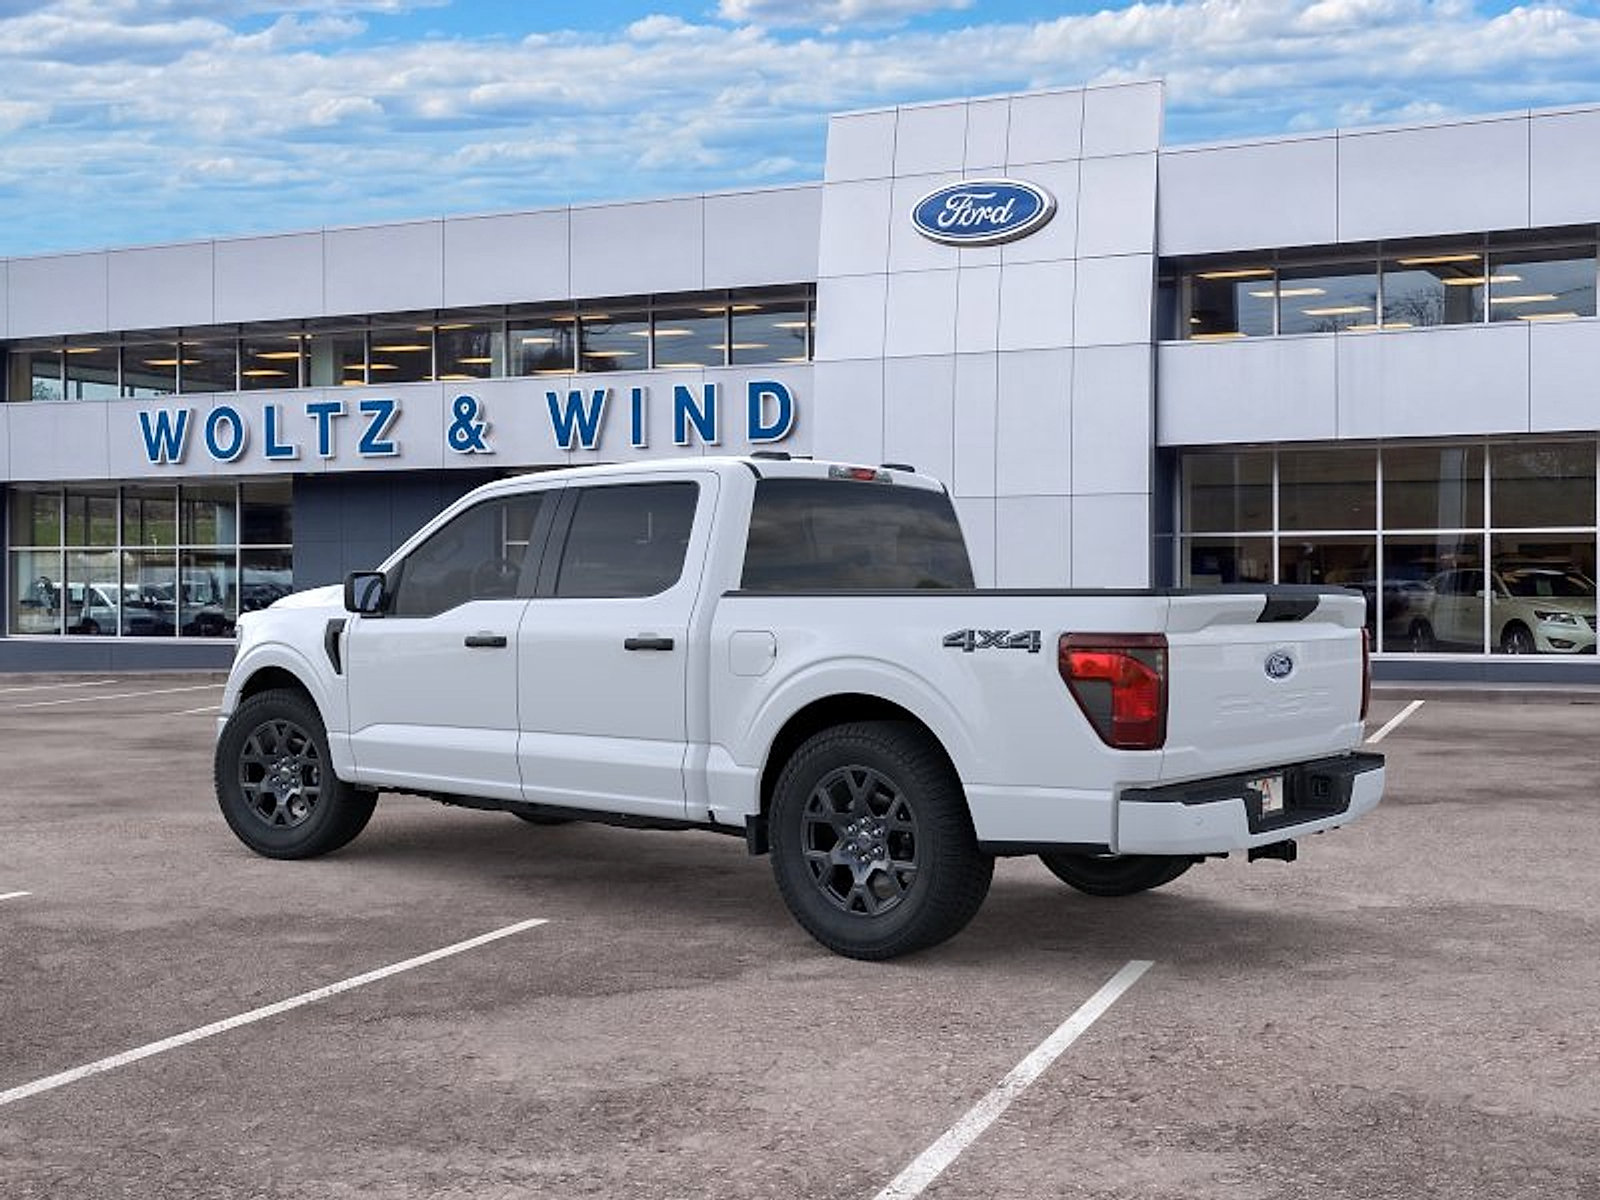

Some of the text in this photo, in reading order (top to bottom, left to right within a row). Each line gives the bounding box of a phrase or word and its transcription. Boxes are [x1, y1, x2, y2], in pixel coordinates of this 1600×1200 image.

[937, 192, 1015, 228] Ford
[138, 379, 797, 464] WOLTZ & WIND
